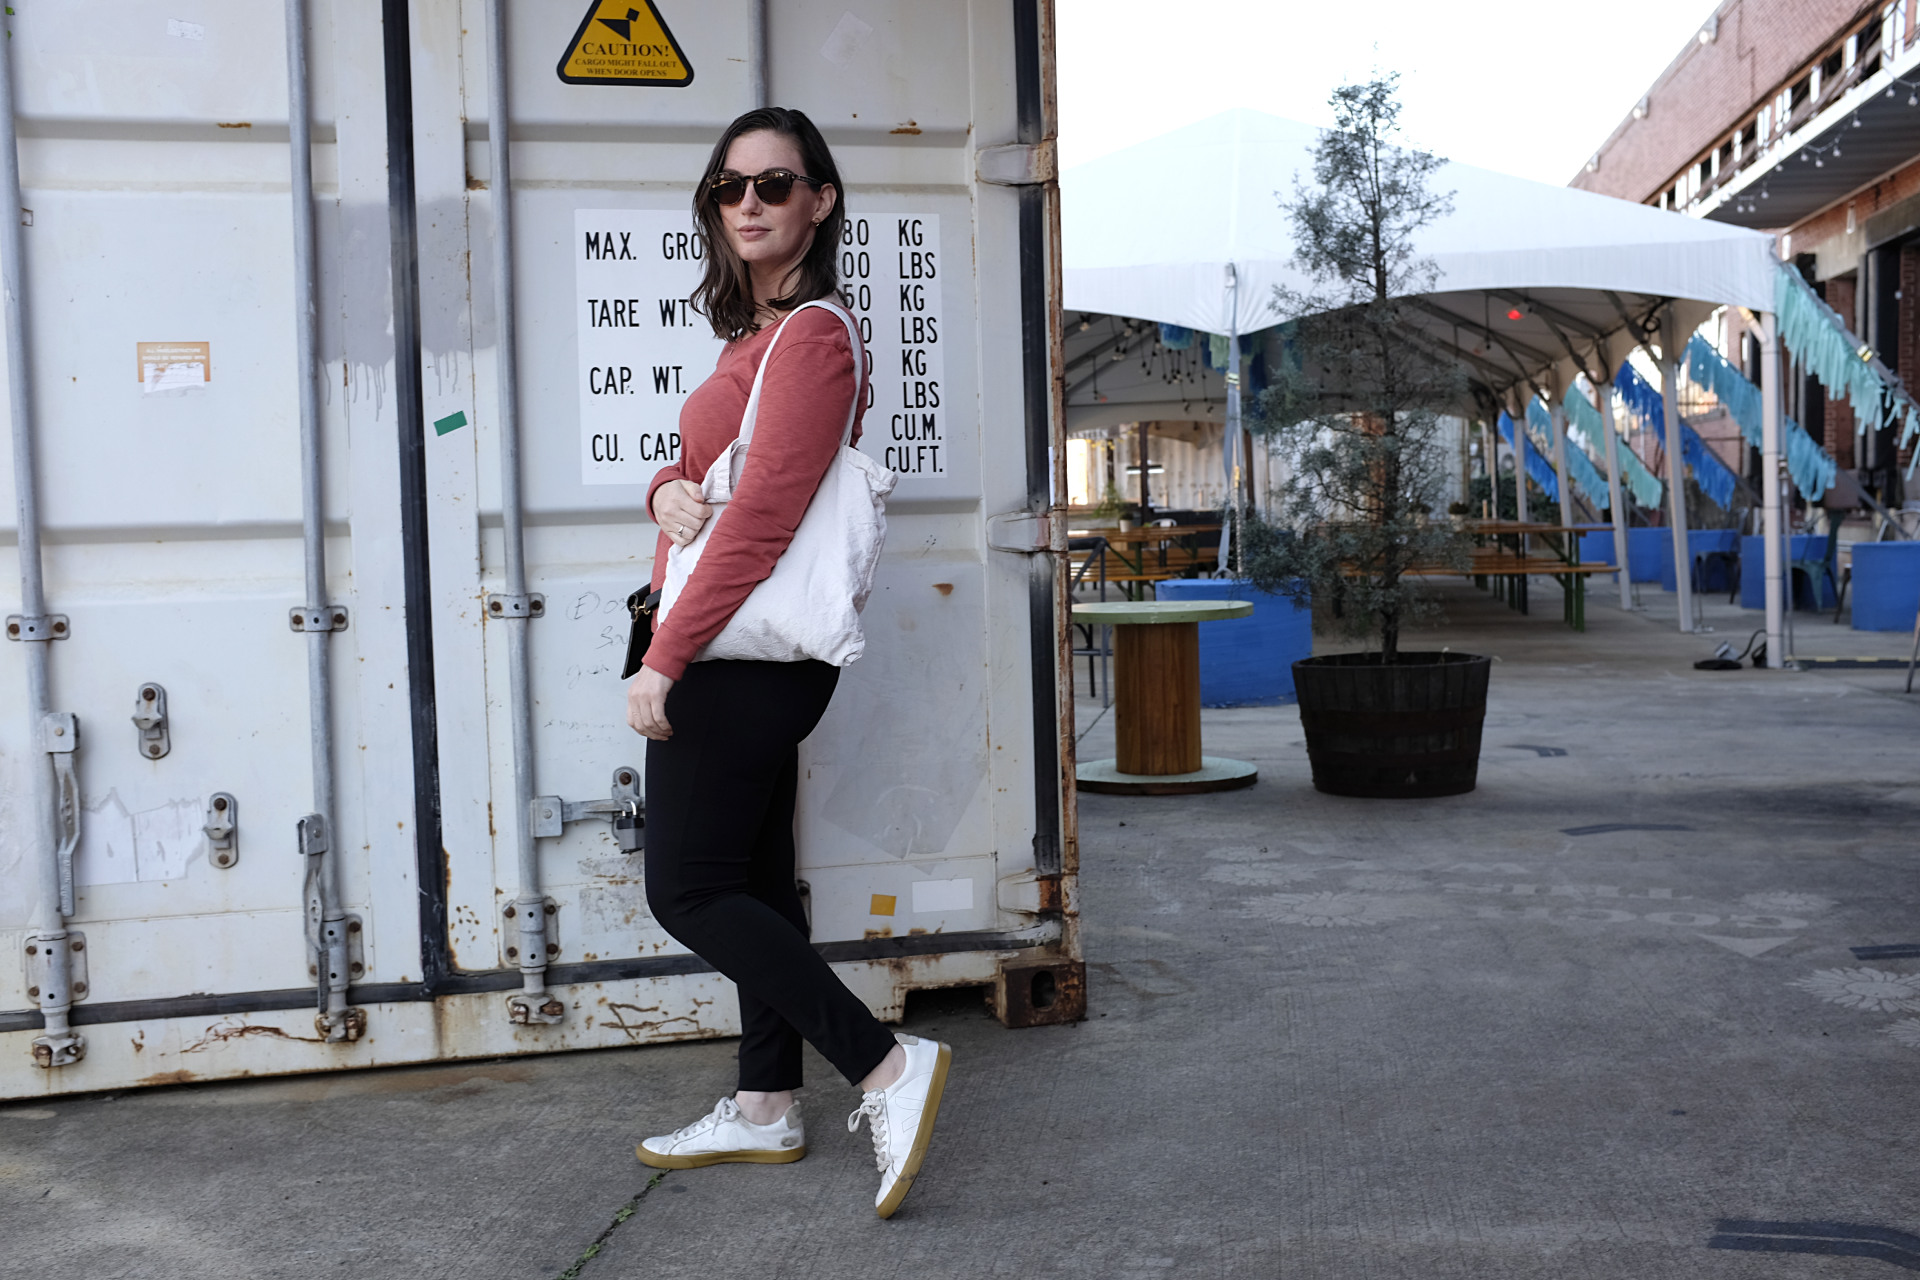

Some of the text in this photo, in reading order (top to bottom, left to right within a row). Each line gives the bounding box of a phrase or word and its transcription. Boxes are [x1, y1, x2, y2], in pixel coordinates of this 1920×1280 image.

[575, 58, 677, 68] CARGO MIGHT FALL OUT
[582, 42, 669, 57] CAUTION!
[586, 67, 668, 77] WHEN DOOR OPENS
[585, 232, 637, 260] MAX.
[898, 219, 923, 246] KG
[899, 251, 936, 279] LBS
[899, 284, 925, 311] KG
[588, 299, 693, 327] TARE WT.
[901, 316, 938, 344] LBS
[901, 349, 927, 377] KG
[590, 366, 687, 395] CAP. WT.
[903, 381, 940, 408] LBS
[892, 414, 942, 441] CU.M.
[592, 433, 624, 462] CU.
[885, 445, 943, 473] CU.FT.
